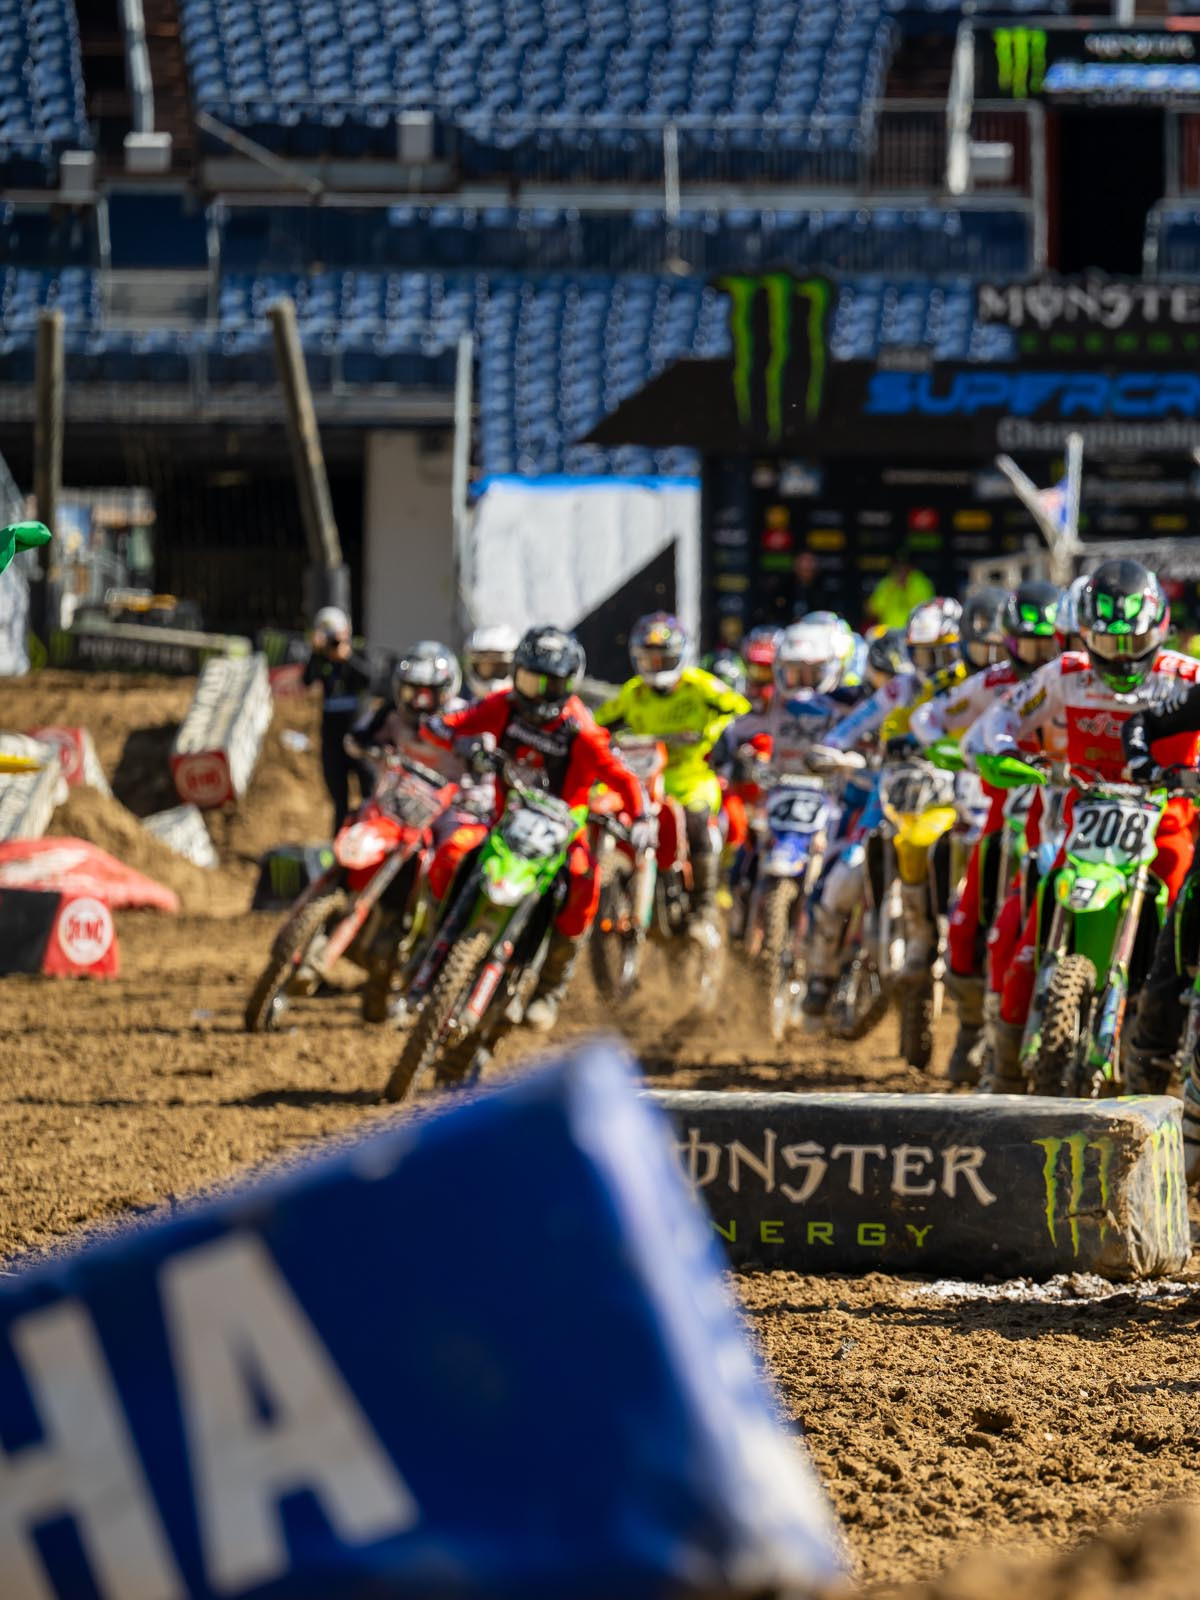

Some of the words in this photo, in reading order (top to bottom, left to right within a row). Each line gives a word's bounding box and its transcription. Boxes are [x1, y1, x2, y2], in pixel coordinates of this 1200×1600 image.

[1071, 809, 1149, 853] 208
[673, 1127, 998, 1207] ONSTER
[710, 1220, 935, 1248] NERGY
